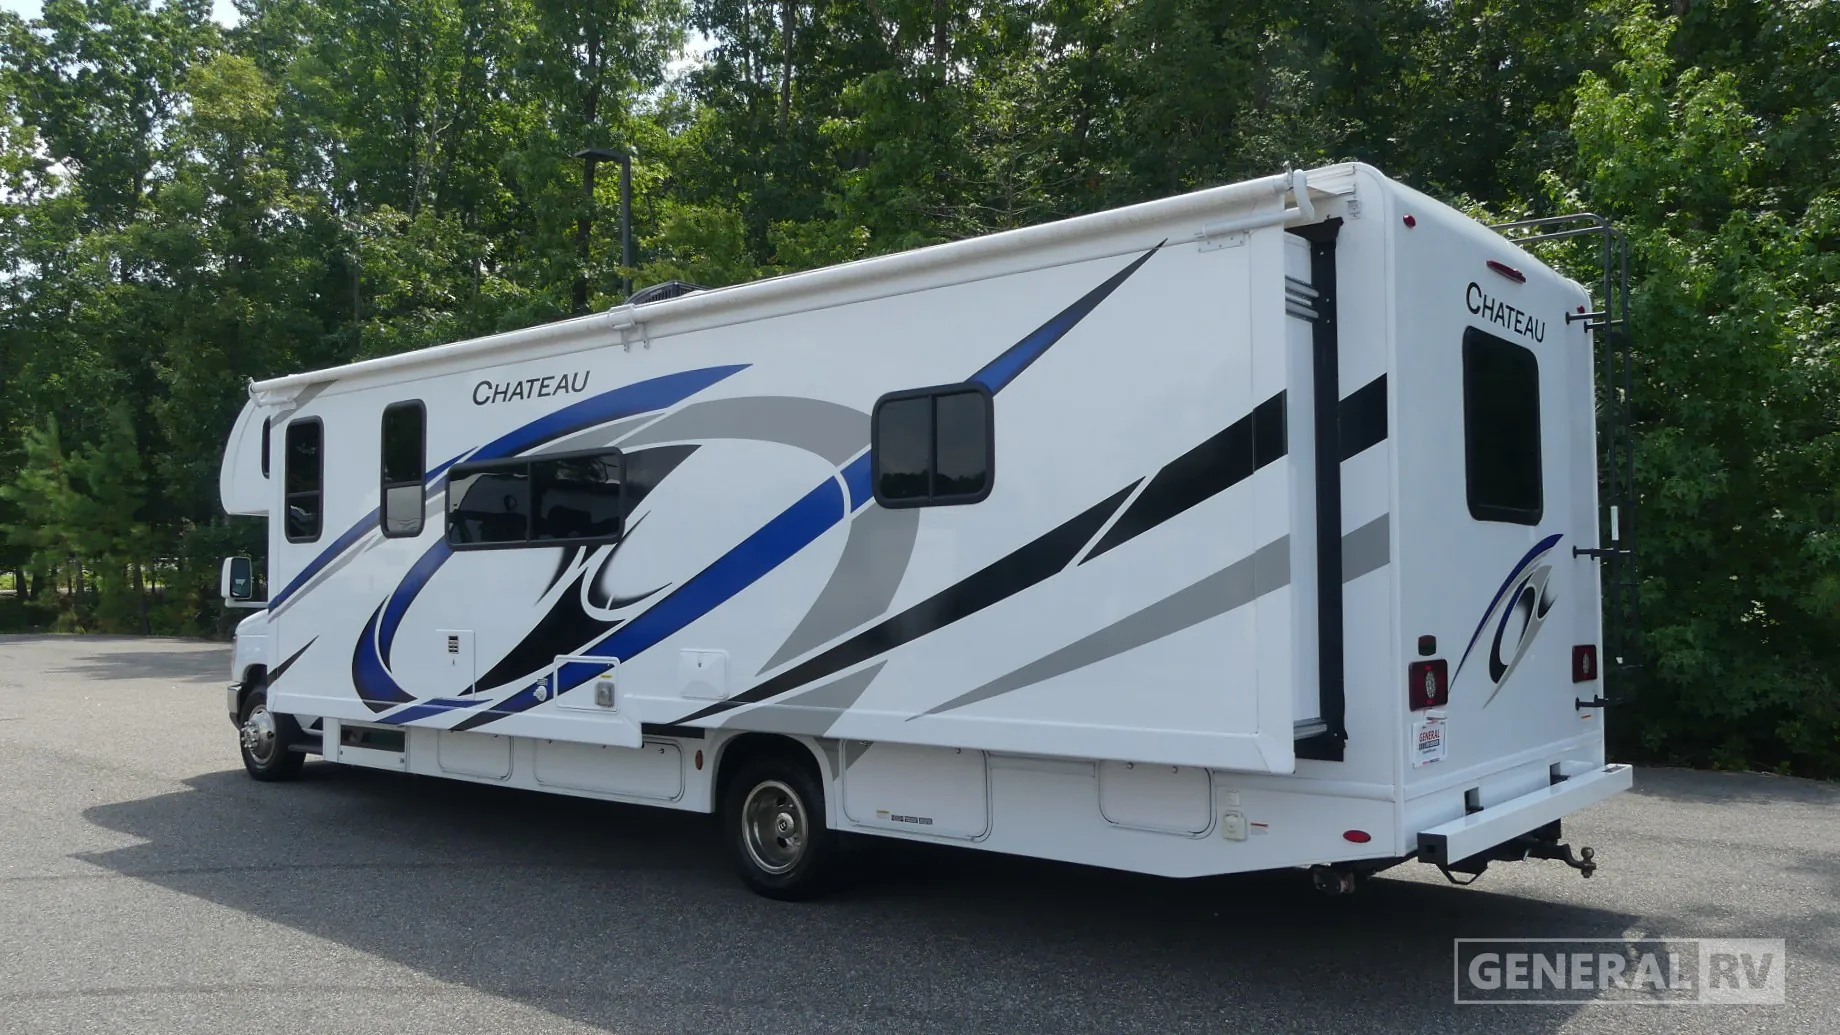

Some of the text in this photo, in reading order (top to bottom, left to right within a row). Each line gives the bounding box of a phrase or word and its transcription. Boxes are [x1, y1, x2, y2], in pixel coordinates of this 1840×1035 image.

[1466, 281, 1546, 343] CHATEAU
[472, 370, 591, 406] CHATEAU
[1419, 729, 1440, 743] GENERAL
